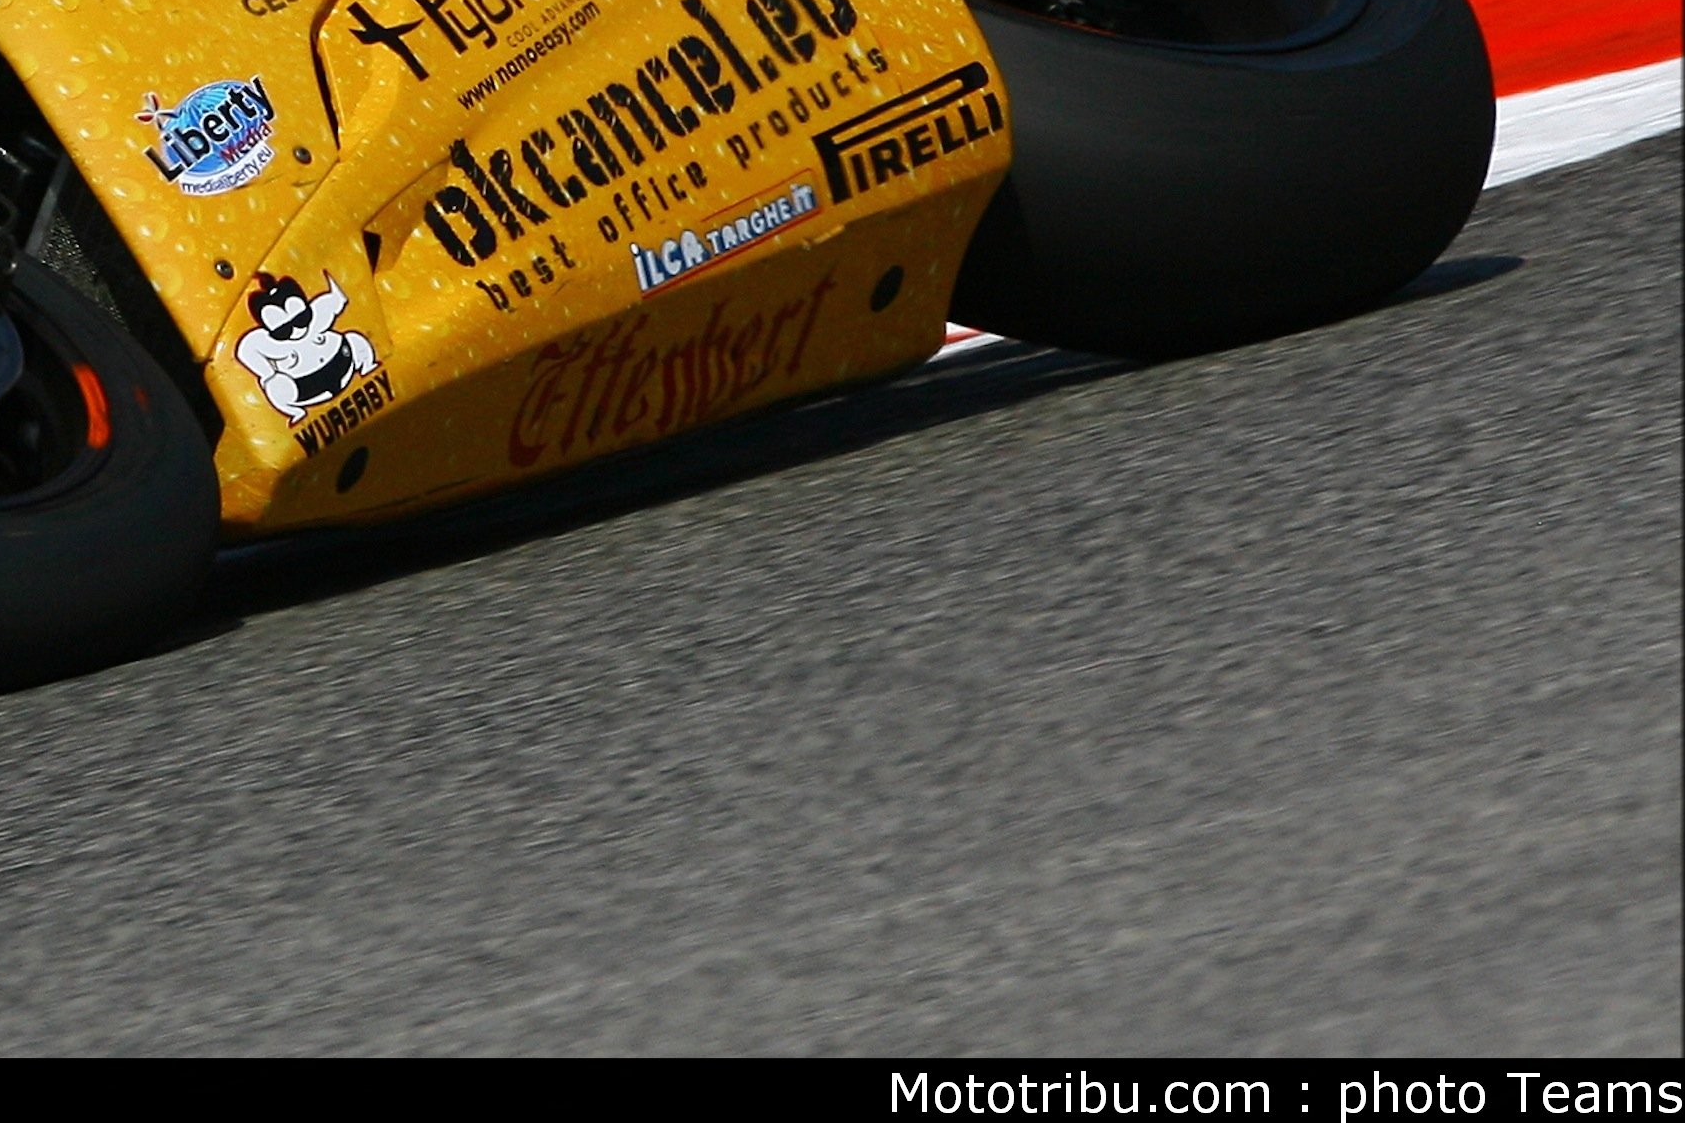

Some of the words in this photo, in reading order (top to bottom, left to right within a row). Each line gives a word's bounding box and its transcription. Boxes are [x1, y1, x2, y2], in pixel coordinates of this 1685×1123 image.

[505, 21, 541, 49] COOL
[145, 76, 276, 181] Liberty
[220, 122, 272, 164] Media
[475, 234, 576, 314] best
[597, 161, 708, 244] office
[726, 47, 890, 170] products
[811, 61, 1005, 205] PIRELLI
